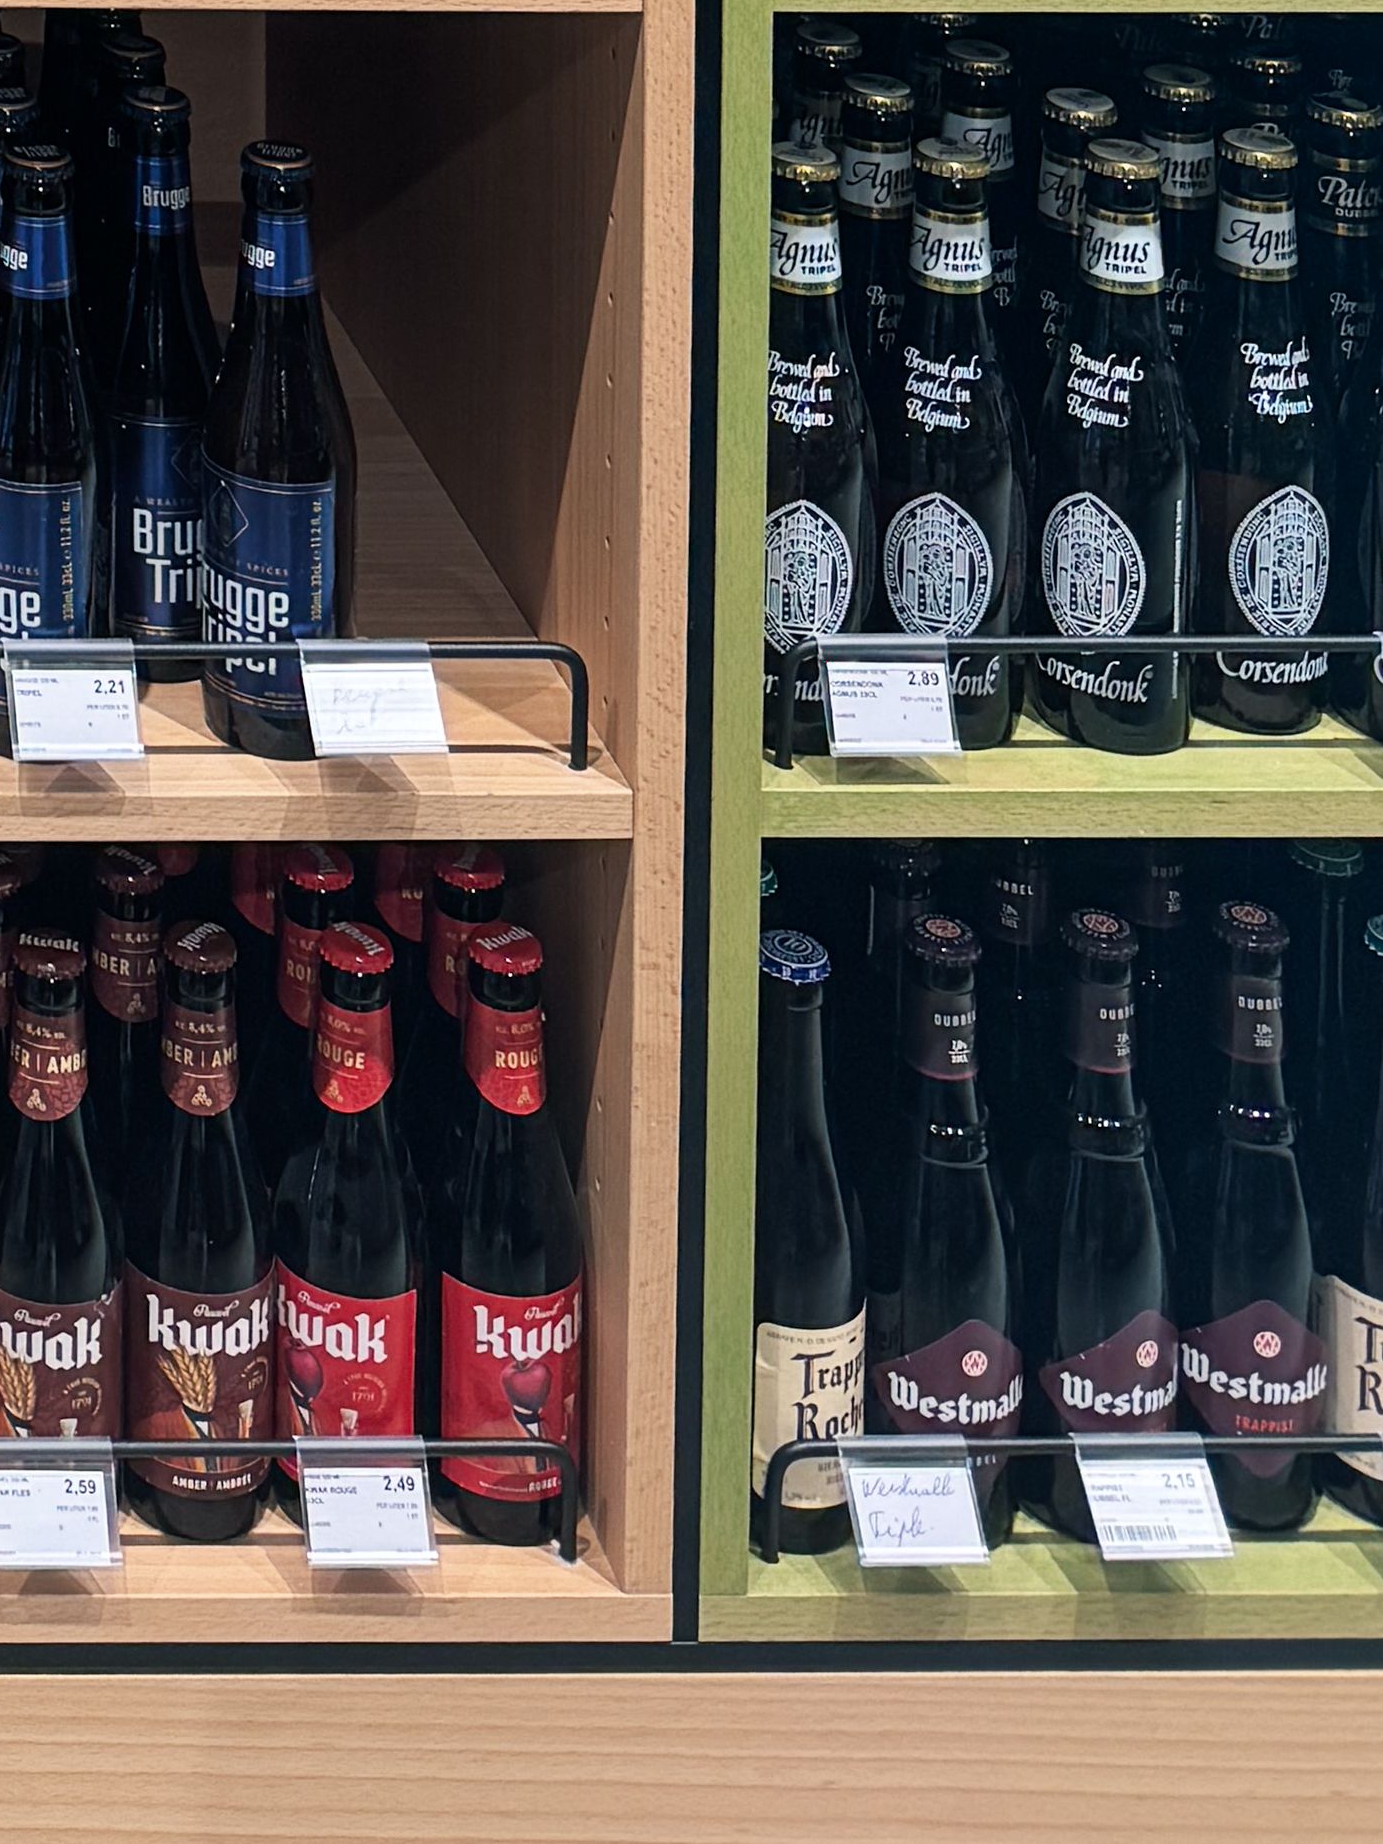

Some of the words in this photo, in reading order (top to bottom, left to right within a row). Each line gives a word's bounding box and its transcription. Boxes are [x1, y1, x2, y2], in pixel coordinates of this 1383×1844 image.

[911, 228, 985, 275] Agnus
[1082, 225, 1151, 274] Agnus
[801, 263, 840, 276] TRIPEL
[943, 263, 984, 275] TRIPEL
[1104, 262, 1147, 275] TRIPEL
[246, 565, 290, 577] SPICES
[907, 670, 940, 686] 2,89
[93, 679, 126, 695] 2,21
[147, 1292, 272, 1365] kwak
[1234, 1414, 1295, 1434] TRAPPIST
[63, 1478, 98, 1495] 2,59
[382, 1475, 416, 1492] 2,49
[1162, 1473, 1195, 1490] 2,15
